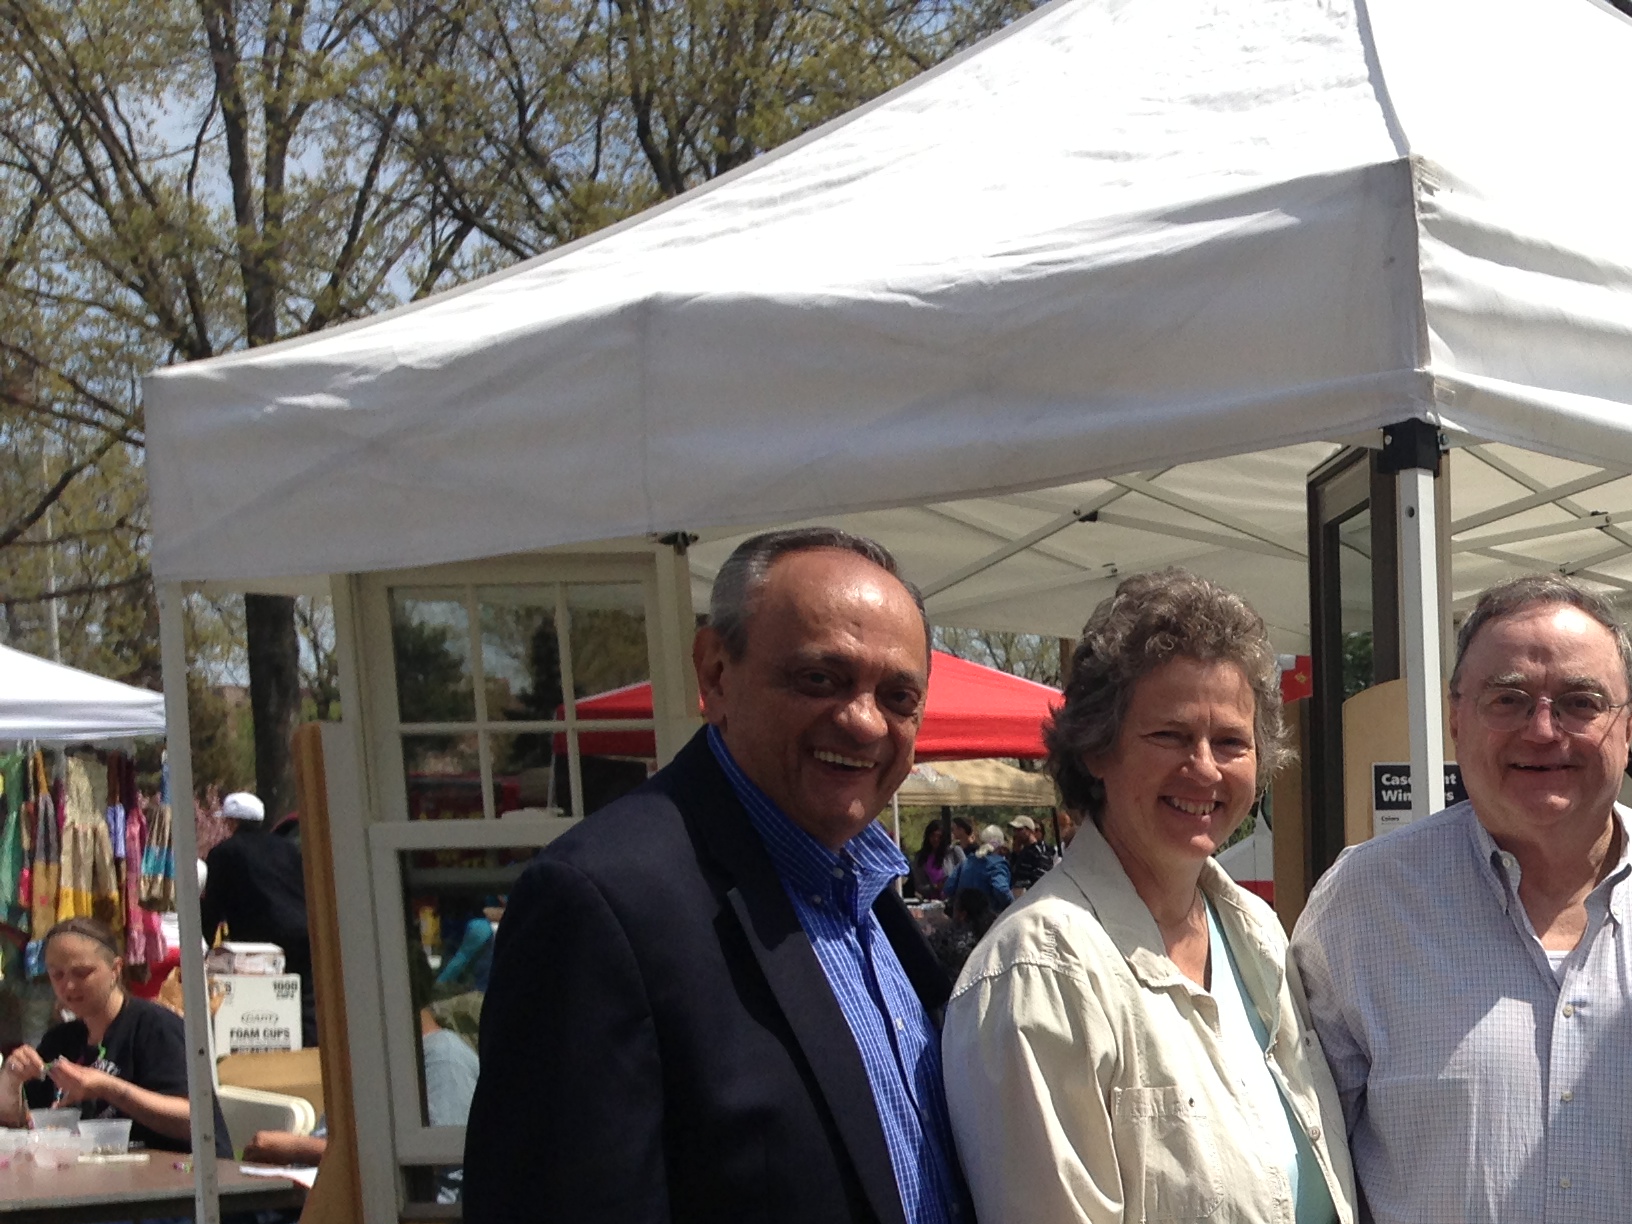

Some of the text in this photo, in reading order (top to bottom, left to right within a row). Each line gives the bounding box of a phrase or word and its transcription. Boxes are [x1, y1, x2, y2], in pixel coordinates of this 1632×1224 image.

[1381, 789, 1455, 802] Wins
[230, 1027, 290, 1038] FOAM CUPS
